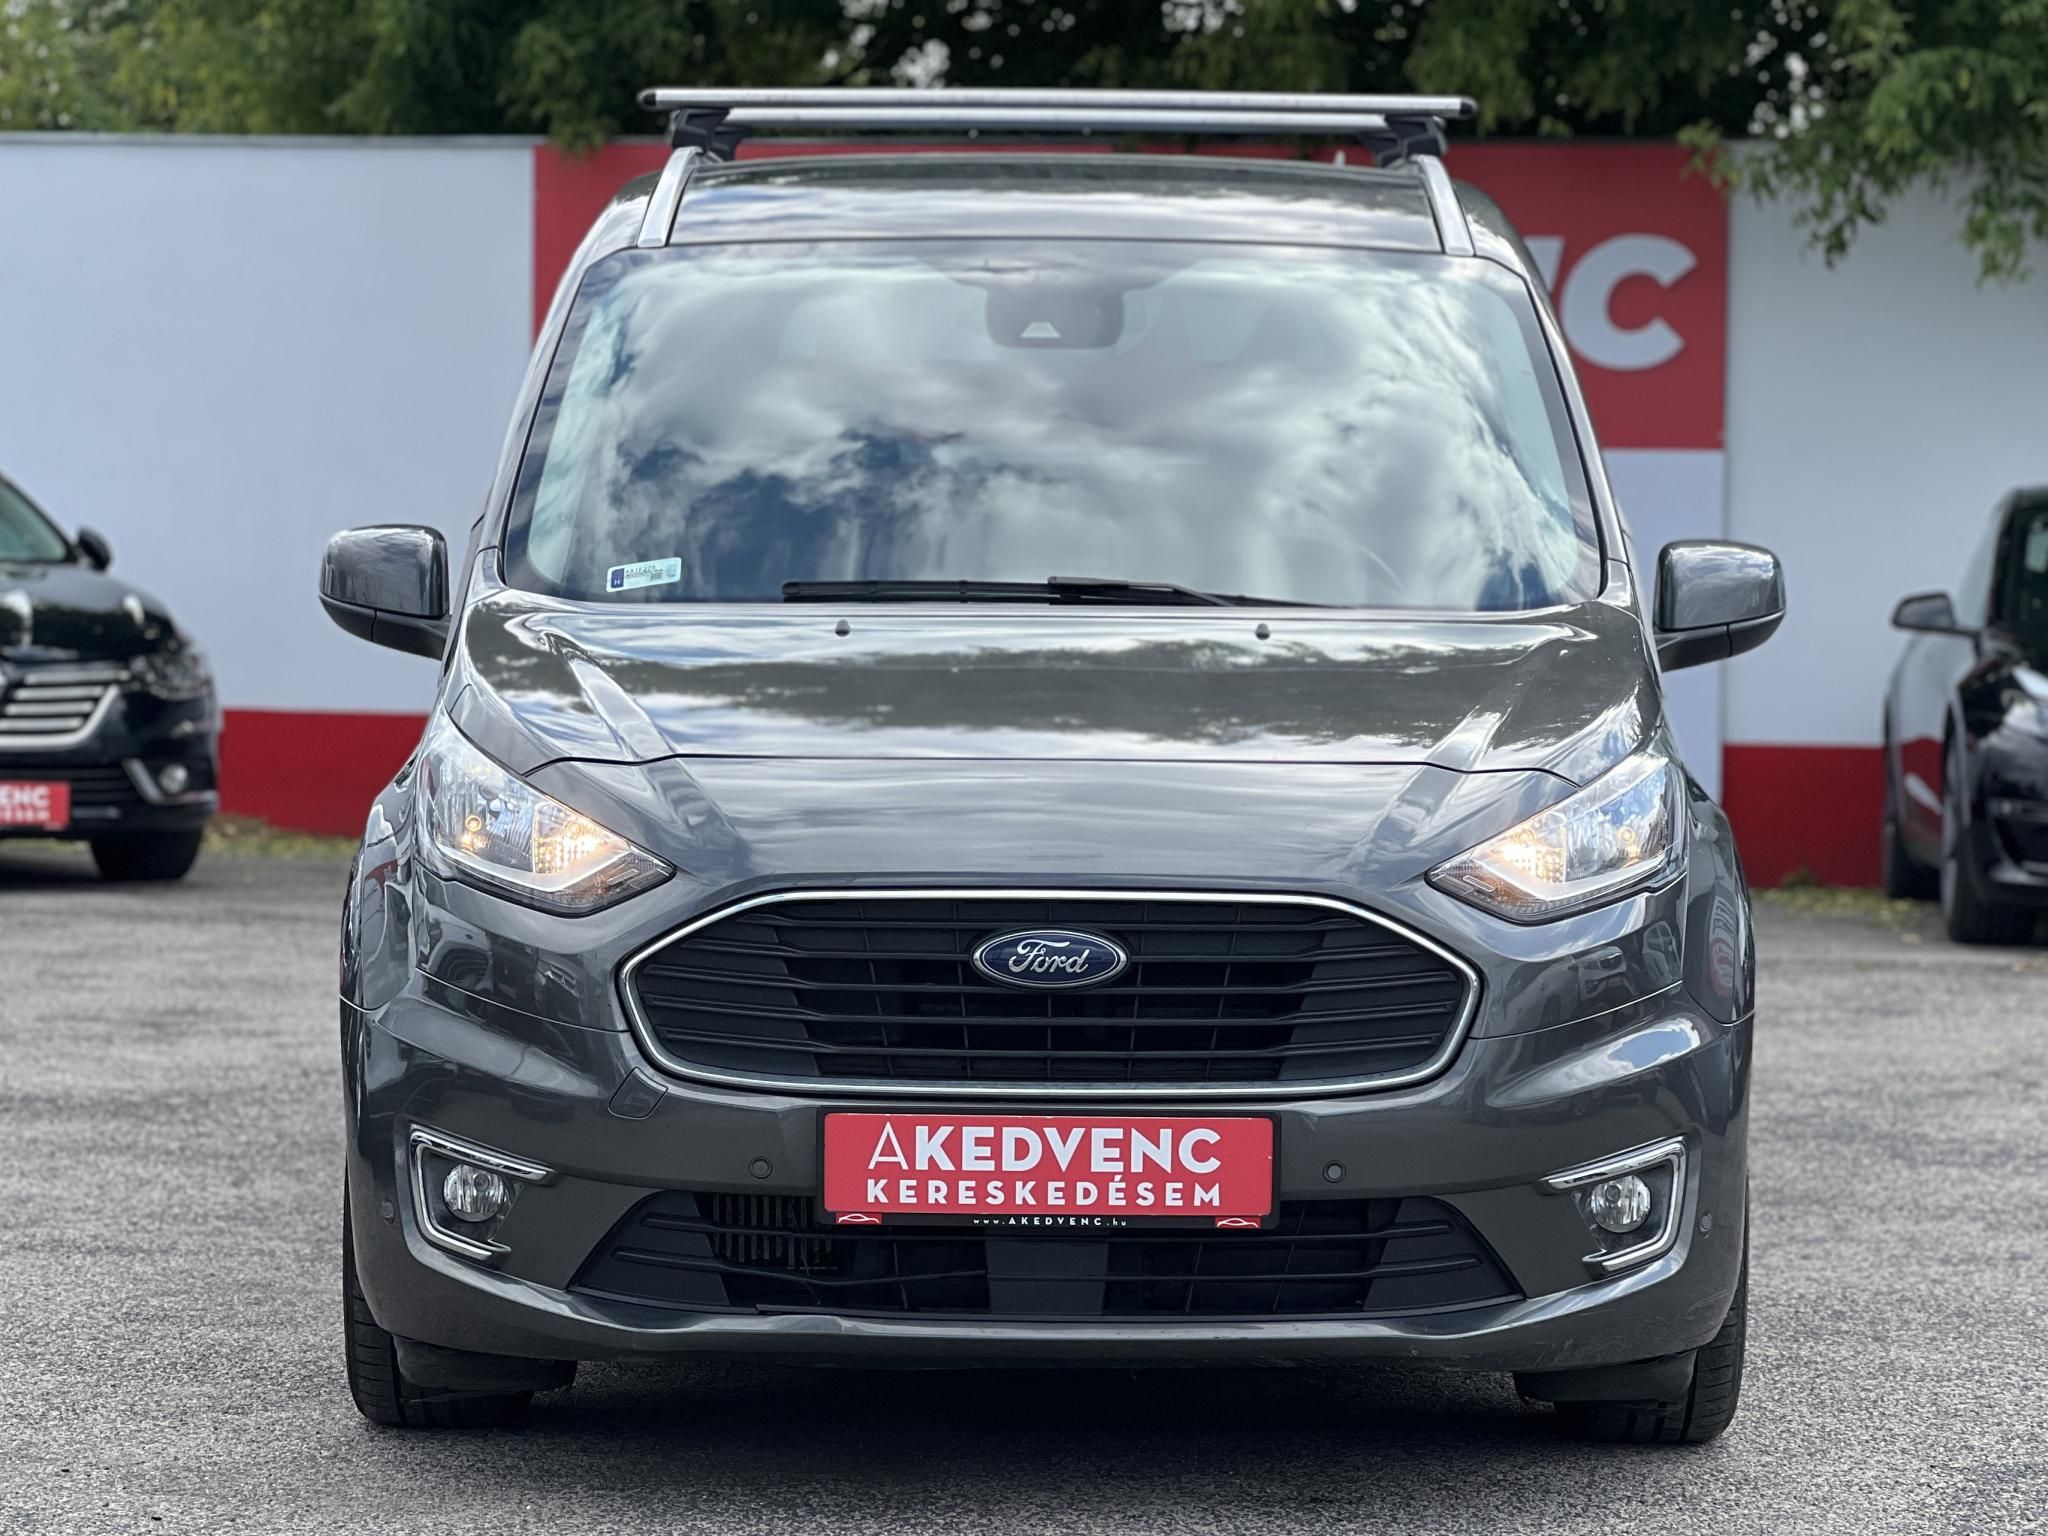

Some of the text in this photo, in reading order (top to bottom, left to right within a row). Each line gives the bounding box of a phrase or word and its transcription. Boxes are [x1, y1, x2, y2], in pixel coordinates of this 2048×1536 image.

[1524, 233, 1697, 371] C
[1008, 939, 1090, 973] Ford
[867, 1175, 1221, 1207] KERESKEDÉSEM
[973, 1216, 1127, 1227] www.AKEDVENC.hu
